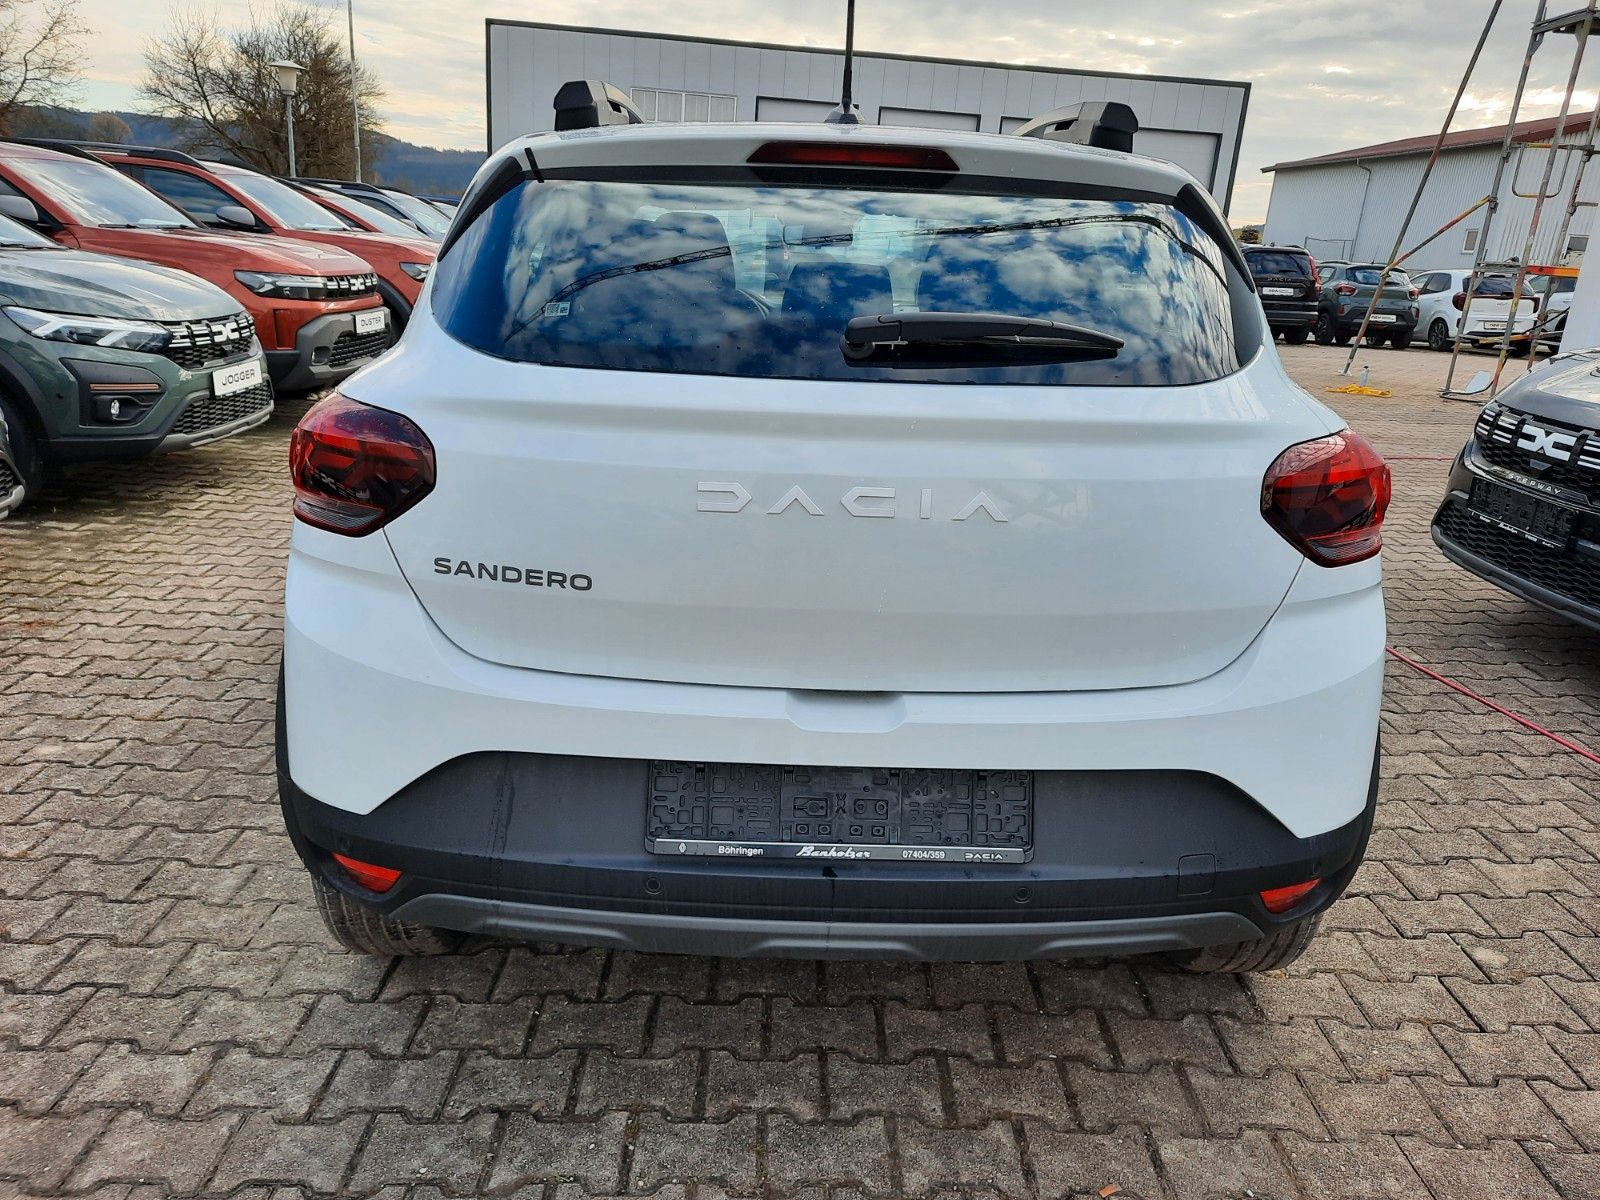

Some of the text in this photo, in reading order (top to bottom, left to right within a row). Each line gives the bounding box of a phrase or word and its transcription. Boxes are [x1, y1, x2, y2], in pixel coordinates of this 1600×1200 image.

[221, 368, 256, 386] JOGGER
[1506, 472, 1562, 495] STEPWAY
[697, 481, 1009, 523] DACIA
[433, 557, 593, 592] SANDERO
[717, 845, 764, 857] Böhringen
[902, 850, 946, 860] 07404/359
[964, 852, 1003, 860] DACIA
